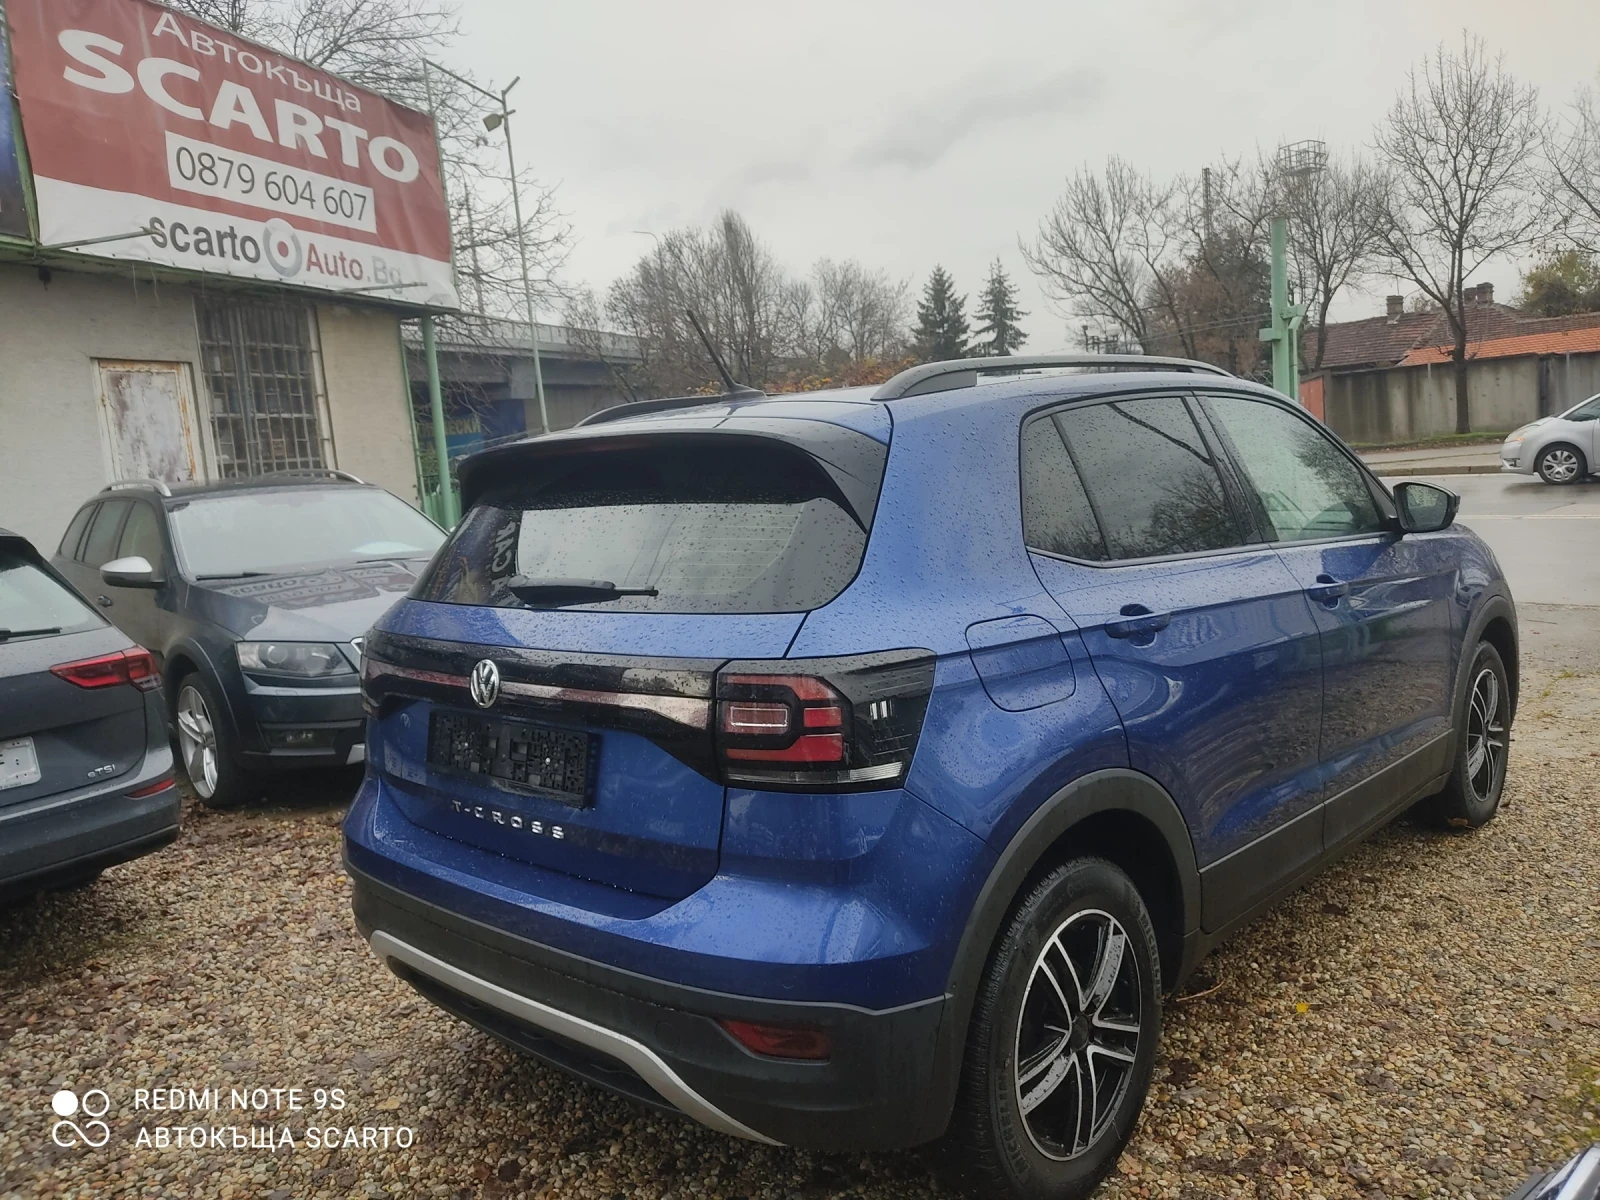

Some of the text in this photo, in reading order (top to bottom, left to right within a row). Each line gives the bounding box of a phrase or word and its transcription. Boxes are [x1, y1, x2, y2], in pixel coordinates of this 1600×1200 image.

[152, 11, 362, 114] Автокъща
[58, 29, 419, 183] SCARTO
[175, 146, 367, 221] 0879 604 607
[149, 216, 261, 264] scarto
[451, 800, 565, 840] T-CROSS
